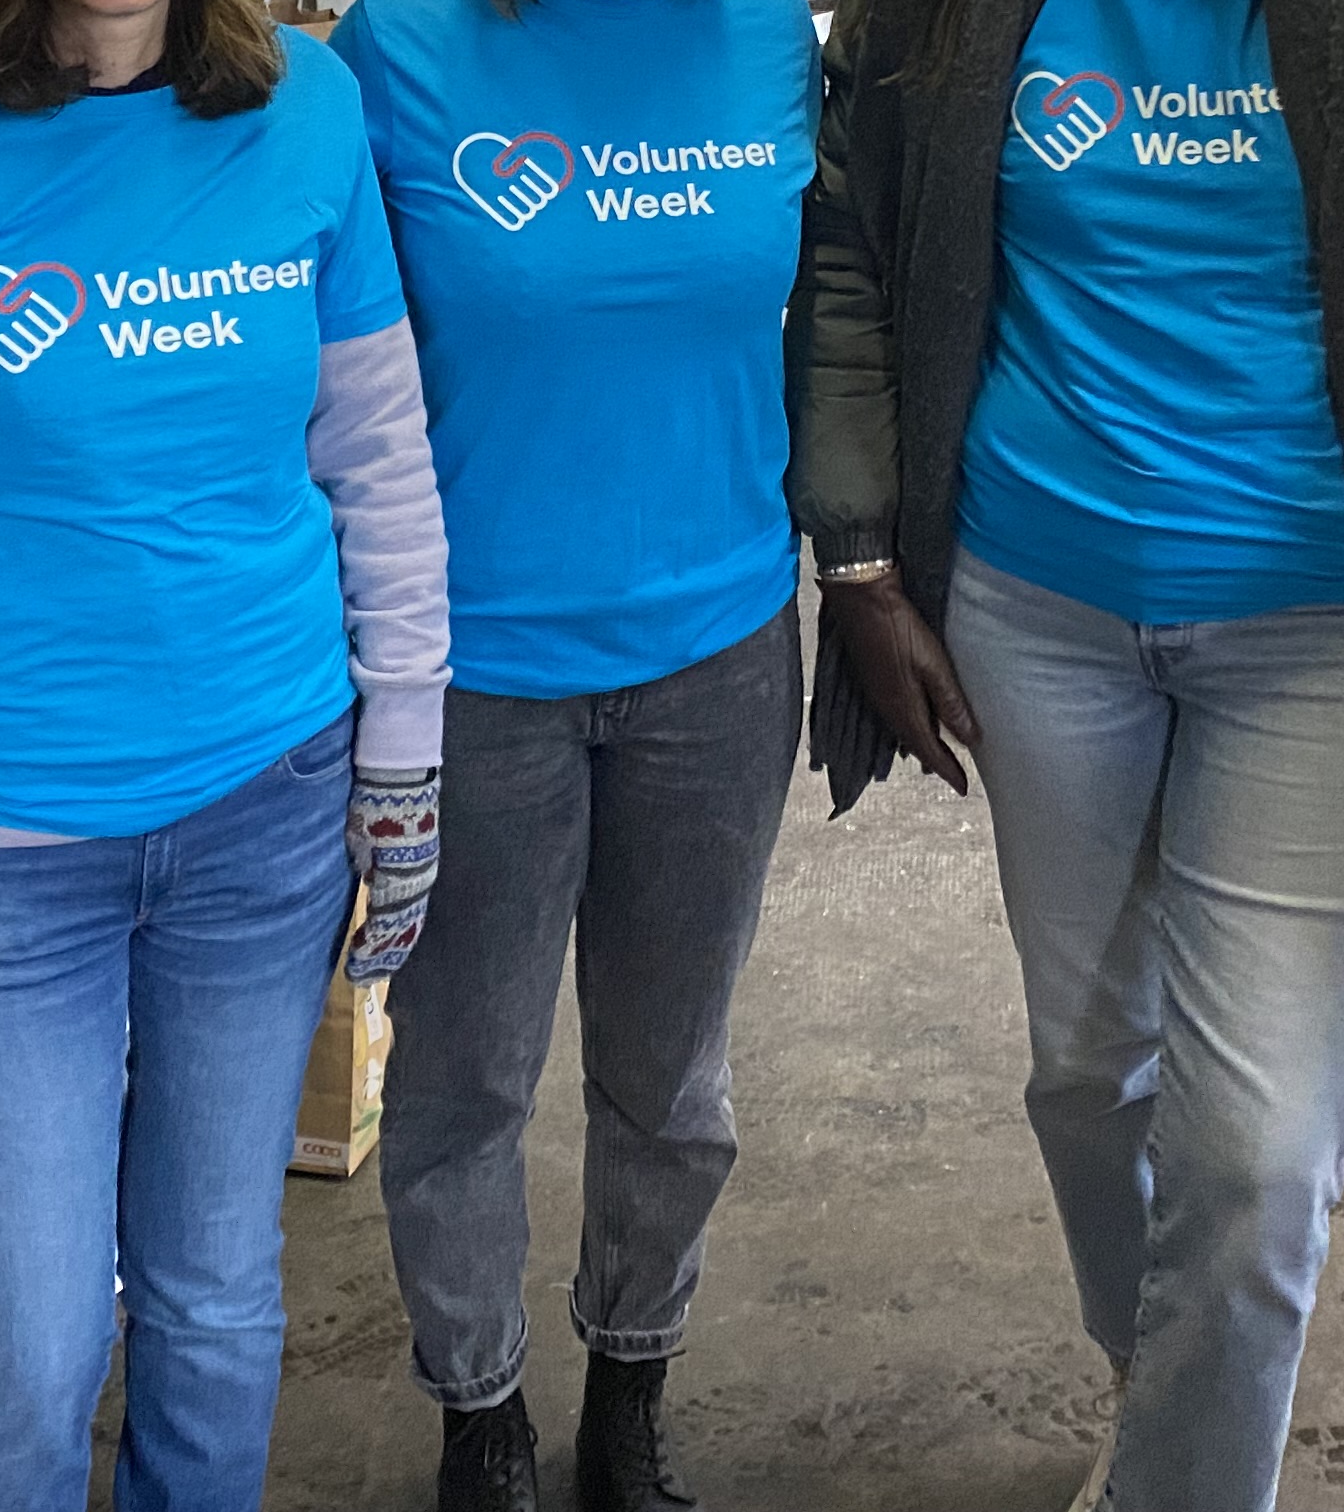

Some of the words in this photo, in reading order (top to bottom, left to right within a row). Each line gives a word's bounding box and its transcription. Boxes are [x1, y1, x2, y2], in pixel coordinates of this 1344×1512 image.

[581, 139, 776, 177] Volunteer
[1131, 129, 1261, 166] Week
[585, 182, 715, 222] Week
[94, 258, 314, 310] Volunteer
[98, 310, 244, 359] Week
